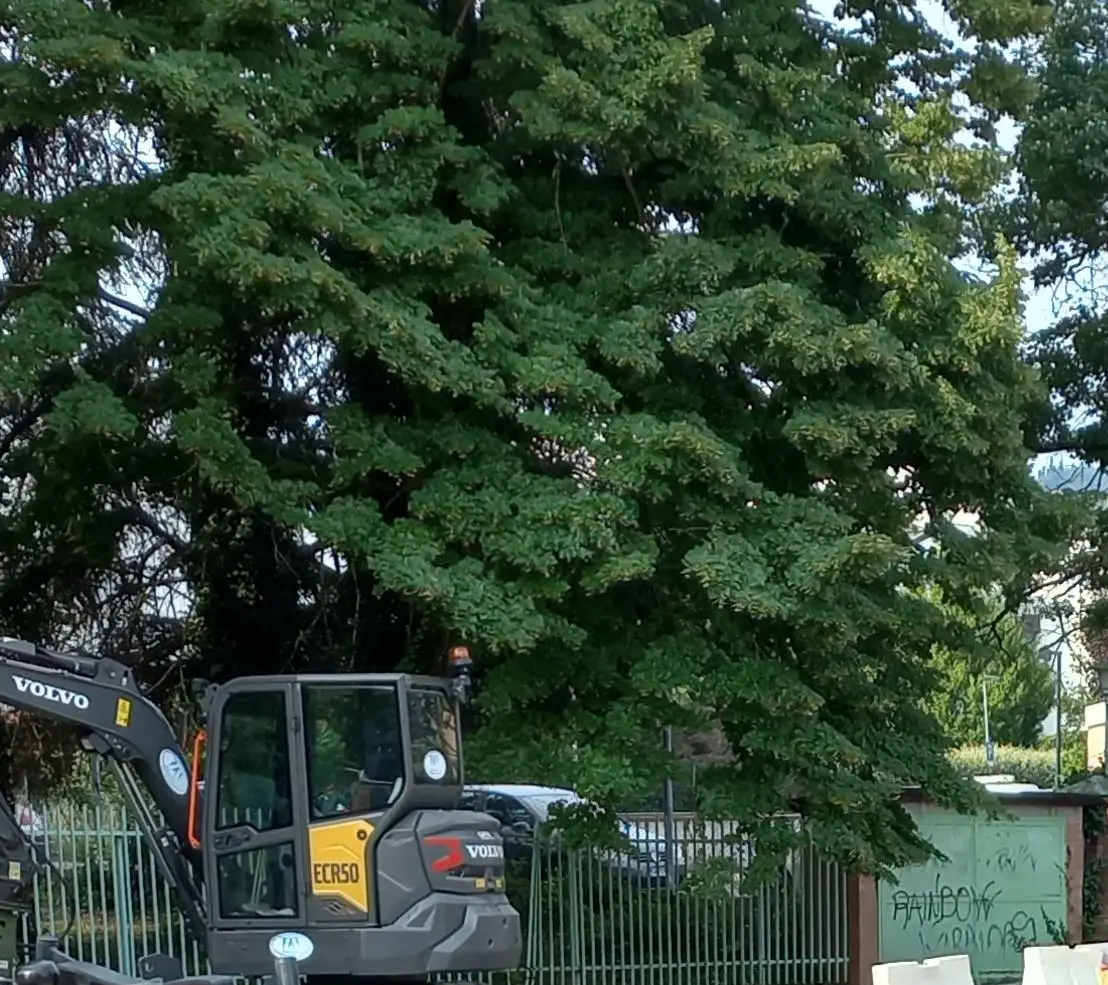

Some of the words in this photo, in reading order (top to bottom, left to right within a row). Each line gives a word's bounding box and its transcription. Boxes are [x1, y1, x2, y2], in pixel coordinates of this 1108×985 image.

[12, 675, 90, 710] VOLVO
[313, 863, 360, 884] ECR50
[892, 872, 1003, 931] RAINBOW
